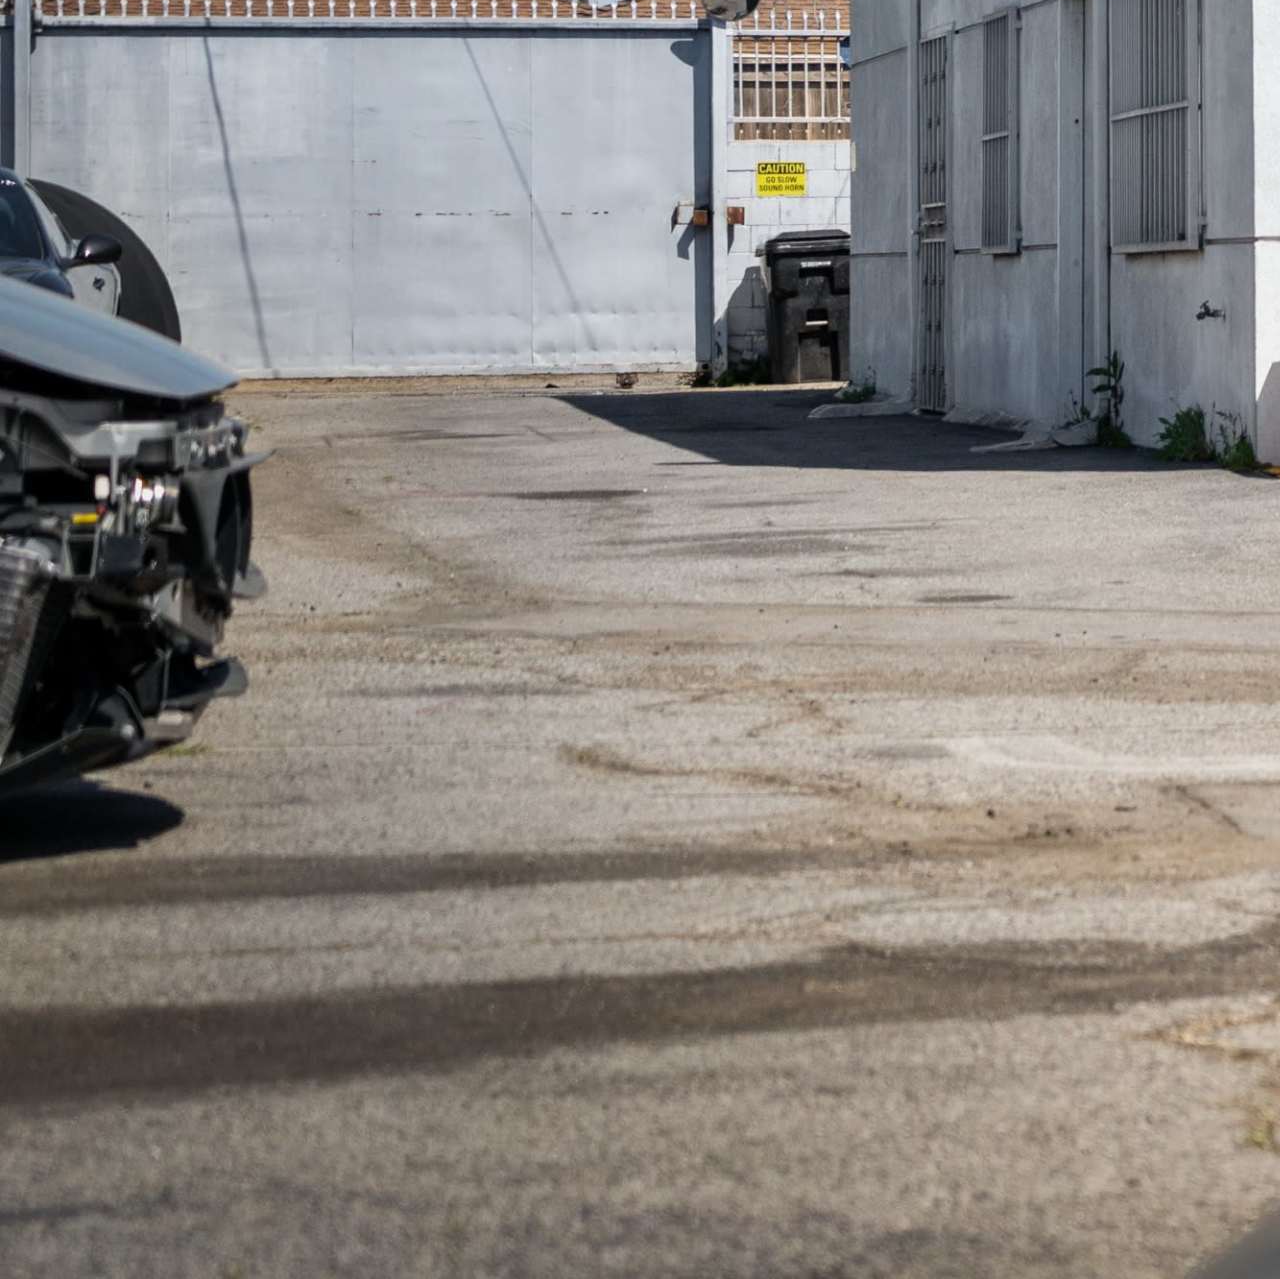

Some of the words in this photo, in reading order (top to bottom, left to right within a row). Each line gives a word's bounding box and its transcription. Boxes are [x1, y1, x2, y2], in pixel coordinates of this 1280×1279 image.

[760, 164, 804, 173] CAUTION
[759, 184, 783, 192] SOUND
[784, 184, 804, 192] HORN
